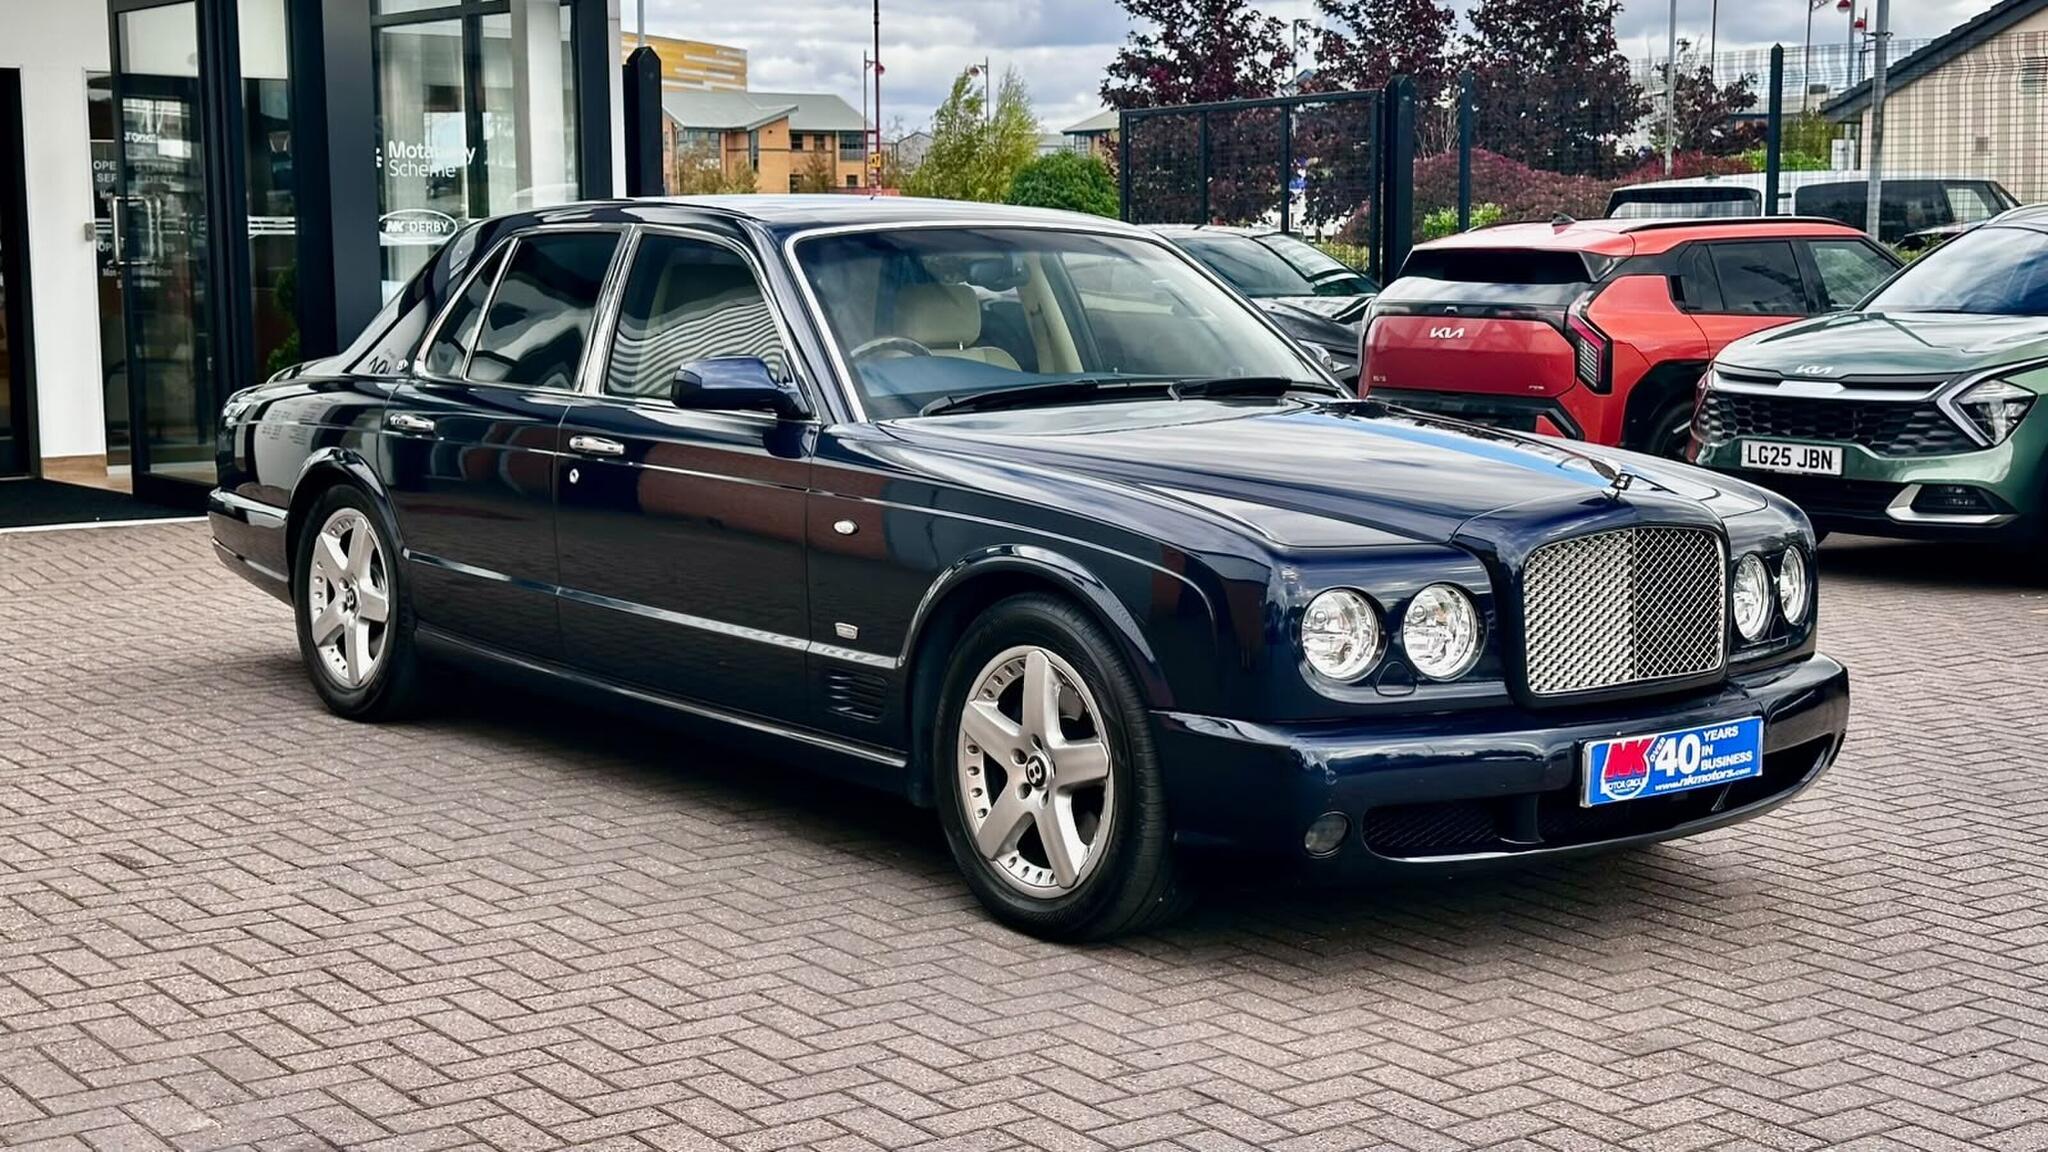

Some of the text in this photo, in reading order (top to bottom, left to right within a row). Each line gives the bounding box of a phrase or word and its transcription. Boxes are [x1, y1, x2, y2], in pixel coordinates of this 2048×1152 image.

[389, 159, 456, 178] Scheme
[409, 221, 449, 233] DERBY
[1429, 327, 1465, 339] KIA
[1795, 364, 1834, 375] KIA
[1747, 444, 1833, 471] LG25 JBN
[1703, 725, 1739, 742] YEARS
[1649, 736, 1666, 762] OVER
[1654, 733, 1700, 777] 40
[1701, 744, 1713, 757] IN
[1700, 750, 1753, 771] BUSINESS
[1654, 767, 1752, 791] www.nkmotors.com
